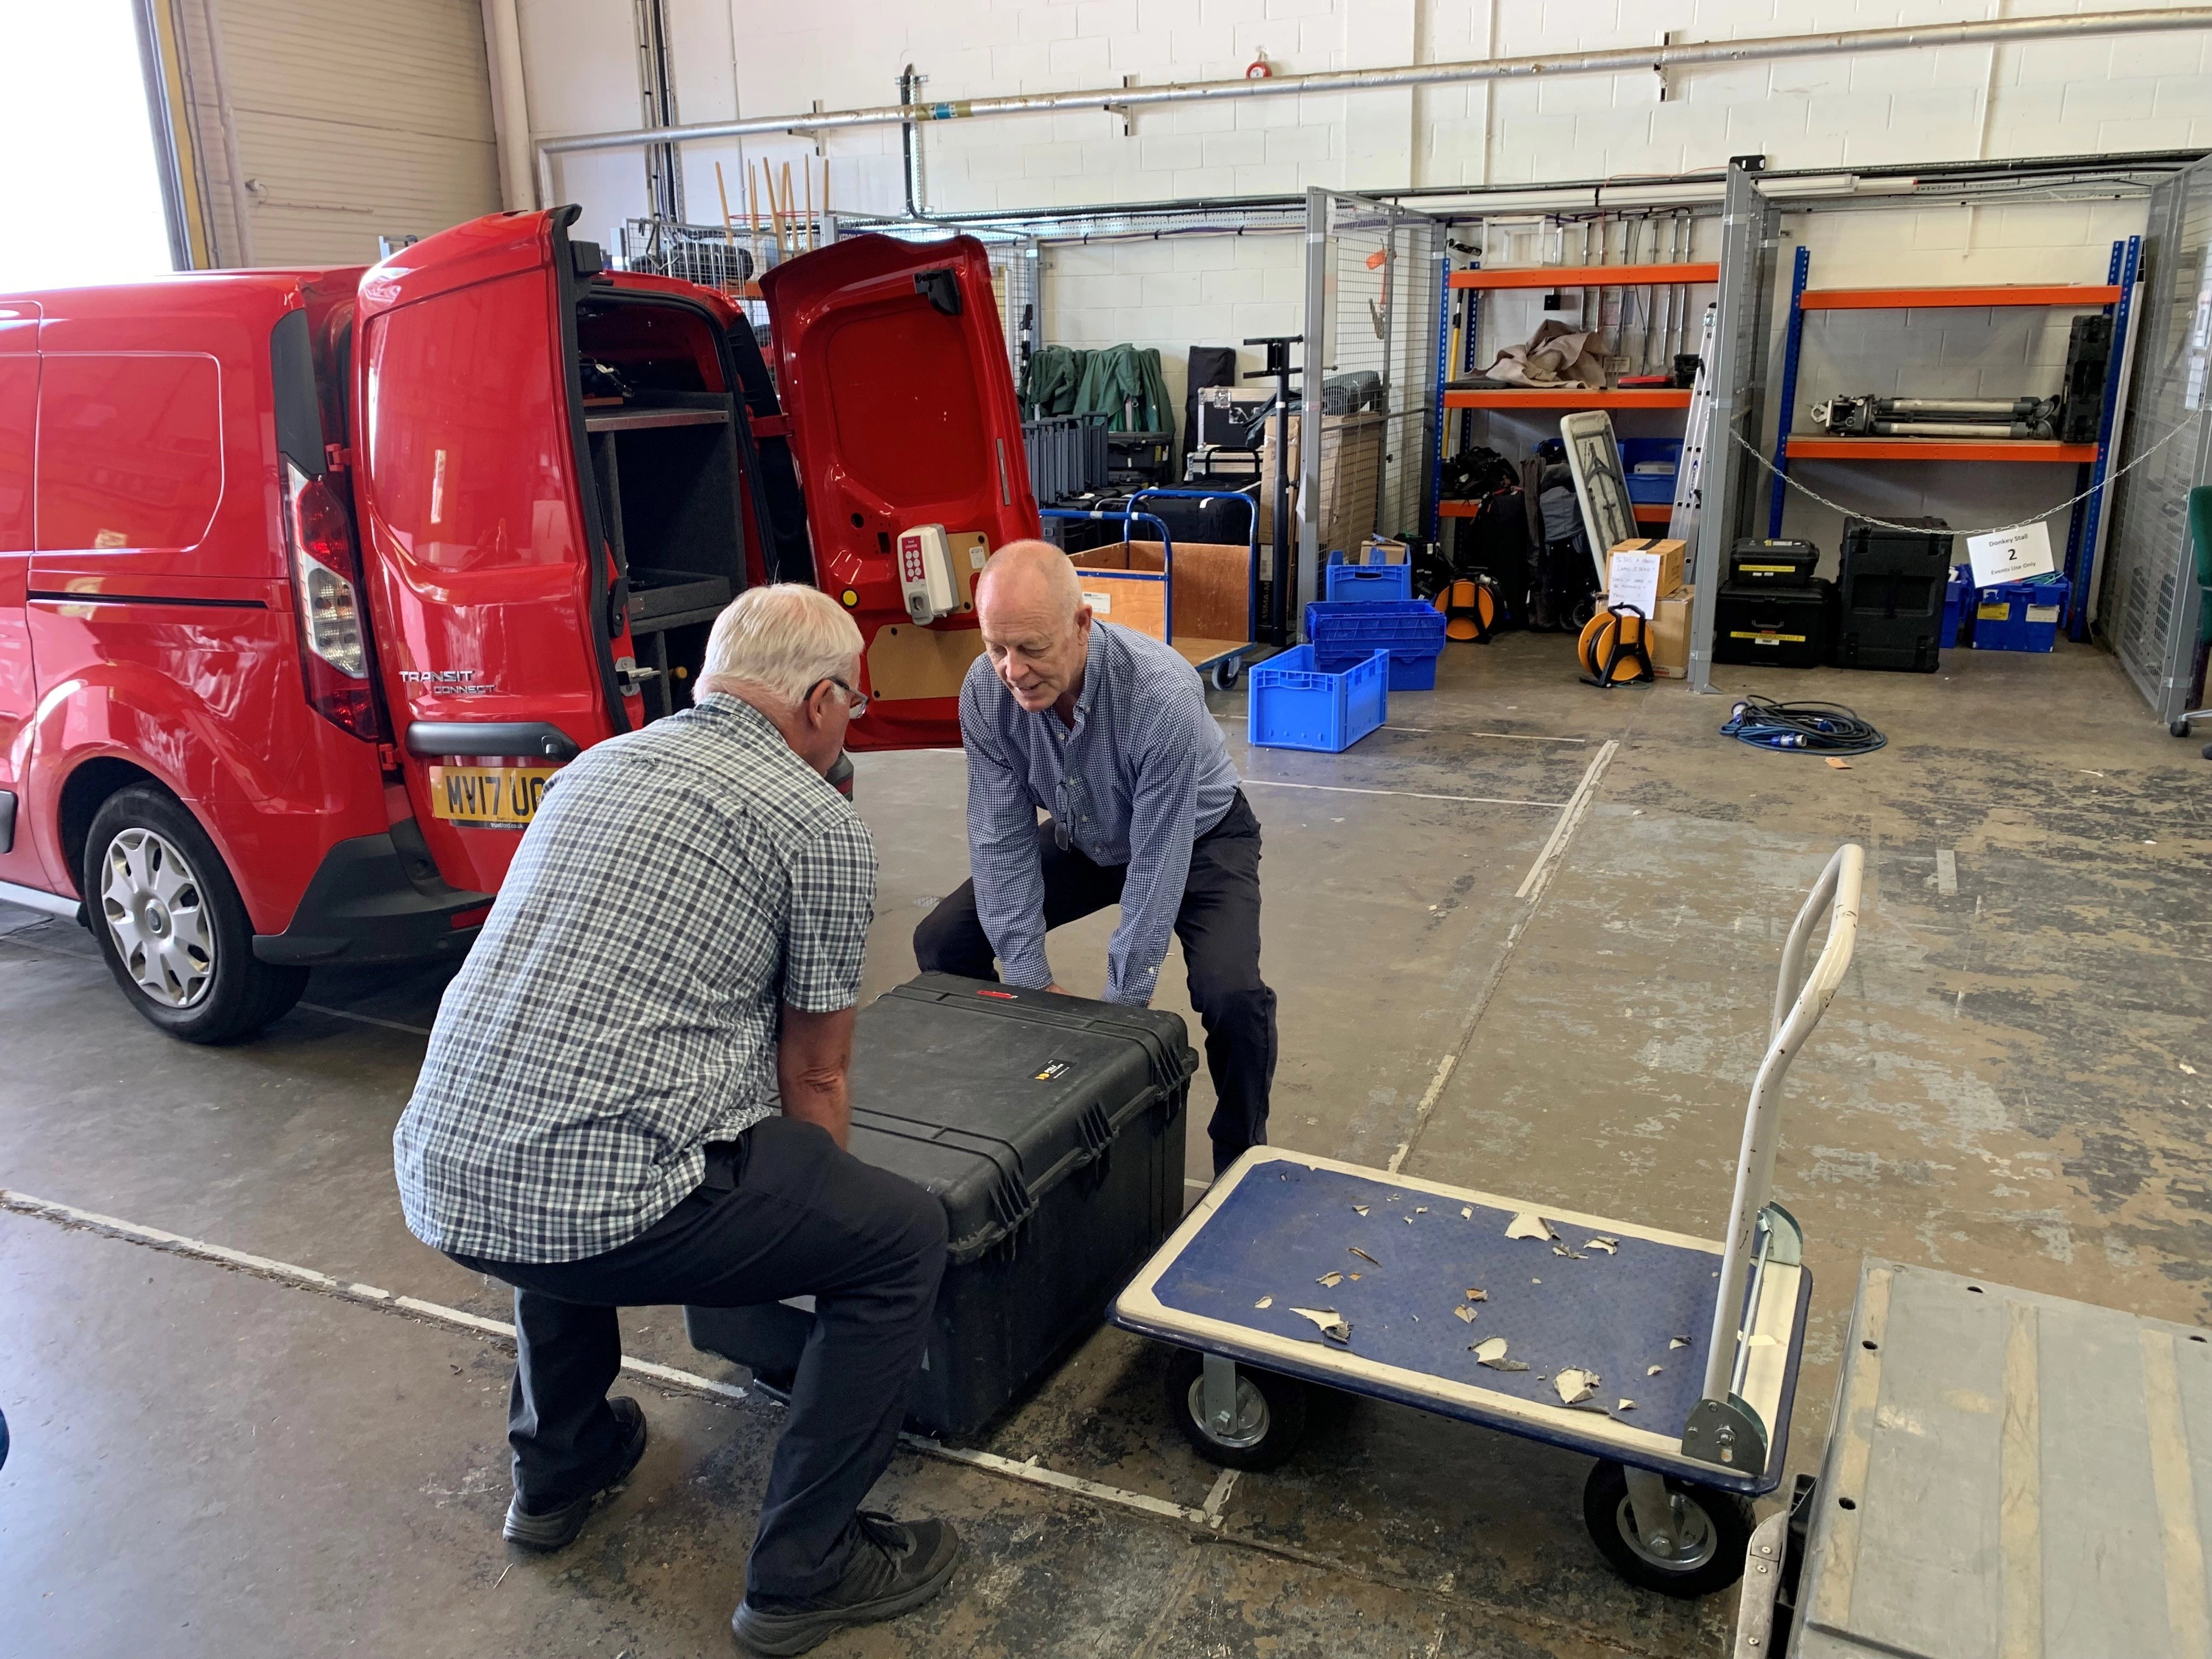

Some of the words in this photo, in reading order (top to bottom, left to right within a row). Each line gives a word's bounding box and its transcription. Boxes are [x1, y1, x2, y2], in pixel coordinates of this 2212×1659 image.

[1989, 538, 2013, 546] Donkey
[2015, 533, 2028, 541] Stall
[2007, 549, 2017, 560] 2
[399, 670, 474, 682] TRANSIT
[433, 684, 496, 695] CONNECT
[446, 775, 500, 815] MV17
